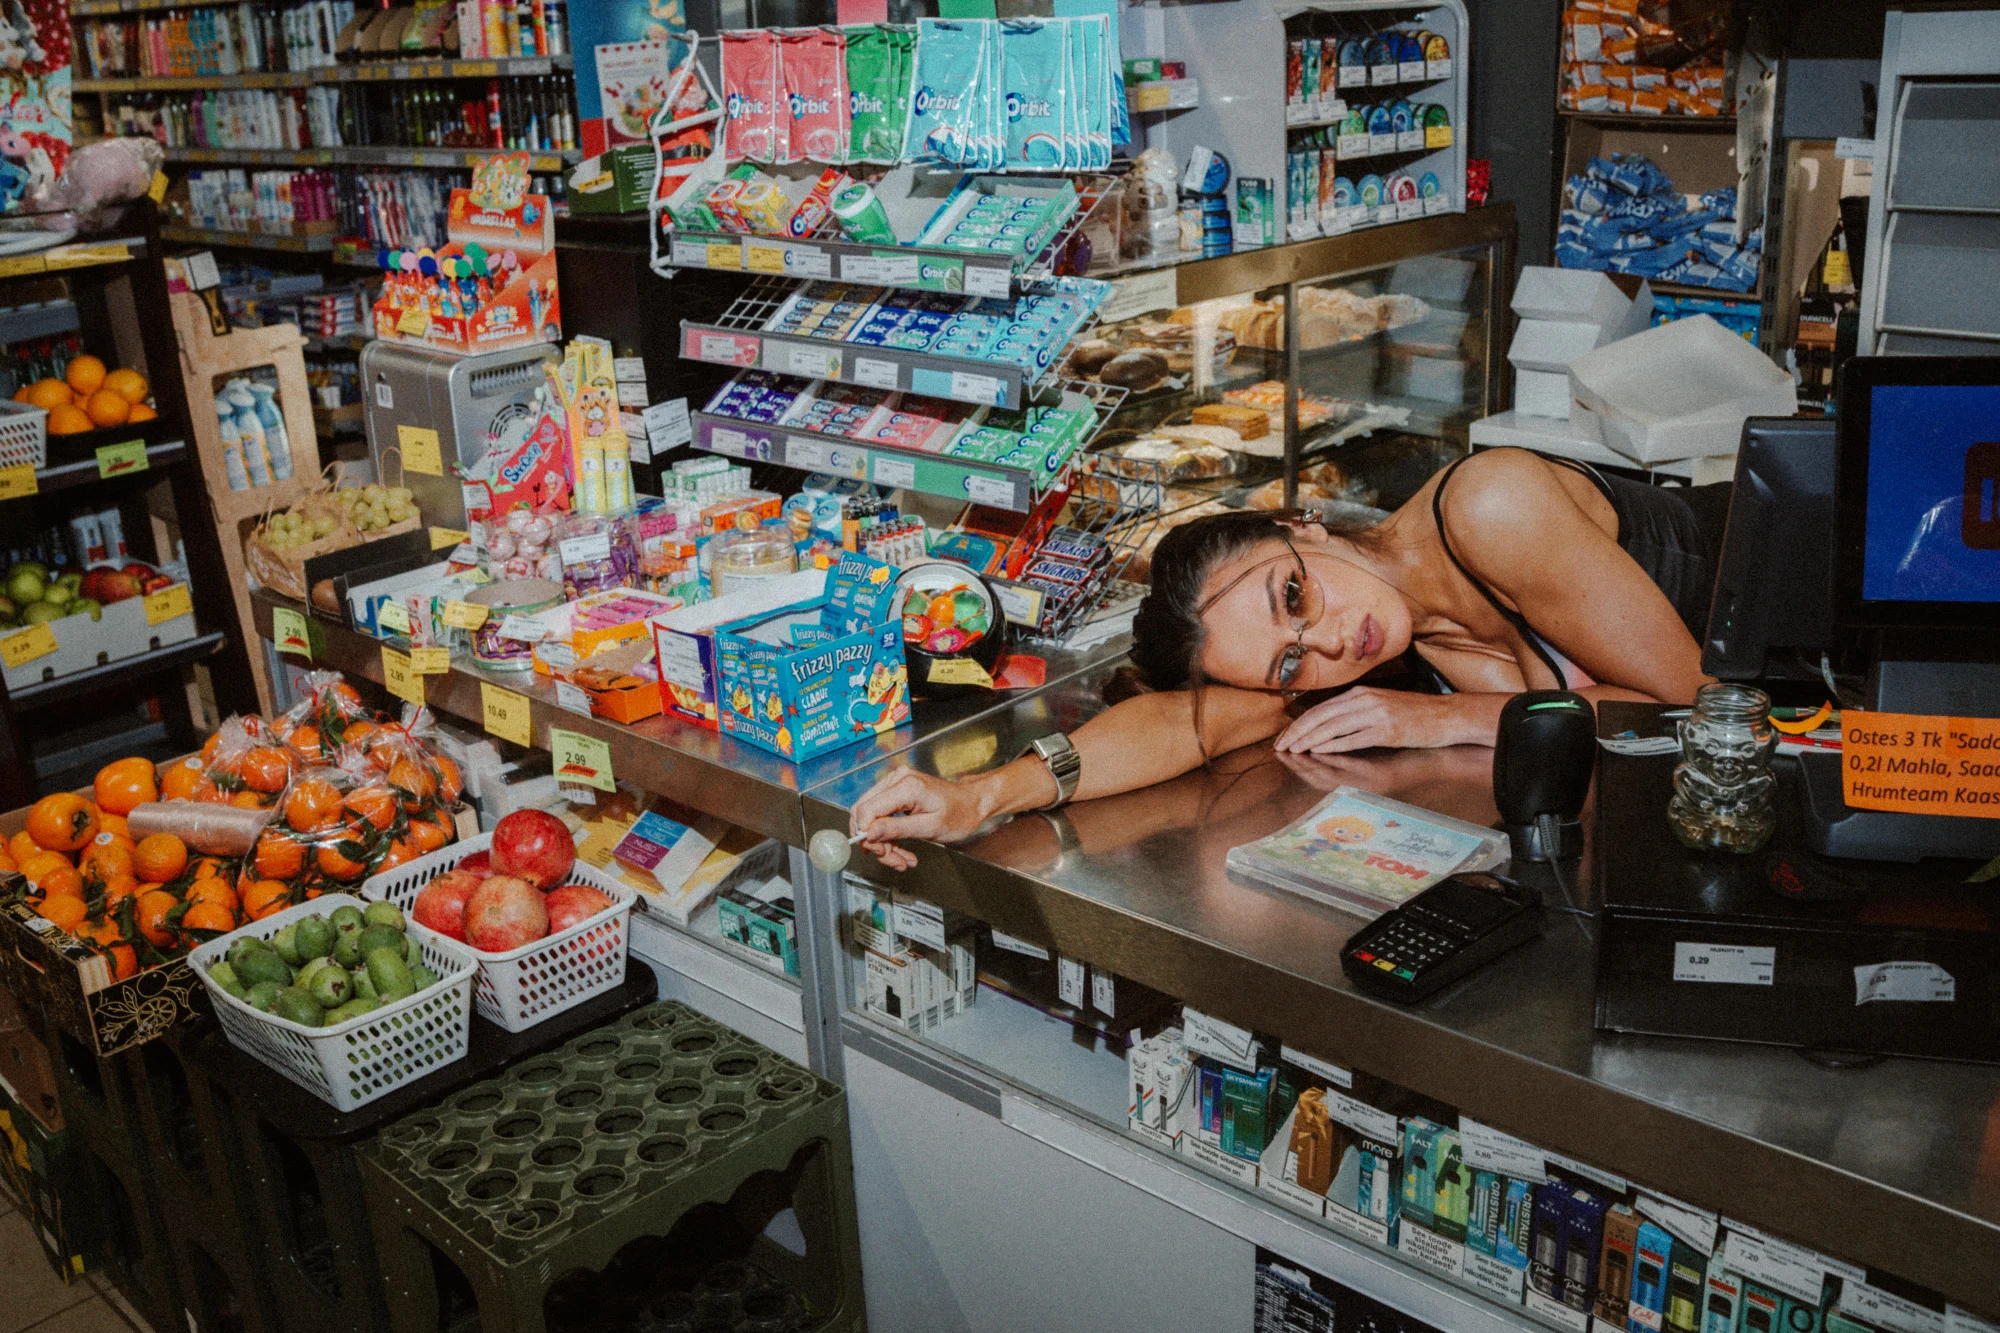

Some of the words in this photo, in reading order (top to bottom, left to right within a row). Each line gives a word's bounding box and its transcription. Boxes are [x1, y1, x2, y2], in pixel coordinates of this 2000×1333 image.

[728, 94, 763, 117] Orbit
[790, 95, 830, 117] Orbit
[851, 95, 883, 116] Orbit
[916, 90, 961, 113] Orbit
[1007, 94, 1051, 119] Orbit
[921, 264, 945, 280] Orbit
[876, 311, 899, 321] Orbit
[917, 316, 941, 326] Orbit
[1046, 438, 1073, 472] Orbit
[1043, 540, 1095, 558] SNICKERS
[839, 554, 867, 583] frizzy
[1033, 560, 1087, 583] SNICKERS
[883, 633, 895, 644] 50
[791, 653, 835, 684] frizzy
[836, 643, 873, 666] pazzy
[390, 667, 404, 683] 2.99
[801, 687, 829, 709] CLAQUE
[488, 704, 507, 720] 10.49
[757, 725, 780, 751] pazzy
[1849, 728, 1898, 747] Ostes
[1903, 731, 1915, 747] 3
[1921, 731, 1943, 748] Tk
[566, 751, 586, 766] 2.99
[1850, 755, 1882, 773] 0,2l
[1887, 757, 1952, 778] Mahla,
[1852, 782, 1948, 803] Hrumteam
[1364, 855, 1431, 880] TOM
[1689, 956, 1709, 965] 0,29
[1194, 1033, 1209, 1044] 7.40
[1362, 1140, 1394, 1158] more
[1411, 1133, 1433, 1149] SALT
[1190, 1139, 1202, 1150] See
[1203, 1146, 1220, 1157] toode
[1220, 1152, 1247, 1171] sisaldab
[1232, 1168, 1241, 1177] on
[1487, 1180, 1501, 1246] CRISTALLITE
[1517, 1193, 1533, 1256] CRISTALLITE
[1411, 1226, 1426, 1239] See
[1428, 1233, 1453, 1250] toode
[1414, 1236, 1449, 1255] sisaldab
[1405, 1238, 1441, 1260] nikotiini,
[1442, 1254, 1457, 1266] mis
[1407, 1246, 1419, 1256] on
[1420, 1251, 1454, 1271] kergesti
[1739, 1250, 1759, 1262] 7.20
[1475, 1254, 1489, 1266] See
[1490, 1260, 1513, 1276] toode
[1477, 1265, 1509, 1283] sisaldab
[1464, 1267, 1495, 1285] nikotiini,
[1495, 1280, 1510, 1291] mis
[1510, 1286, 1521, 1296] on
[1857, 1294, 1879, 1309] 7.40
